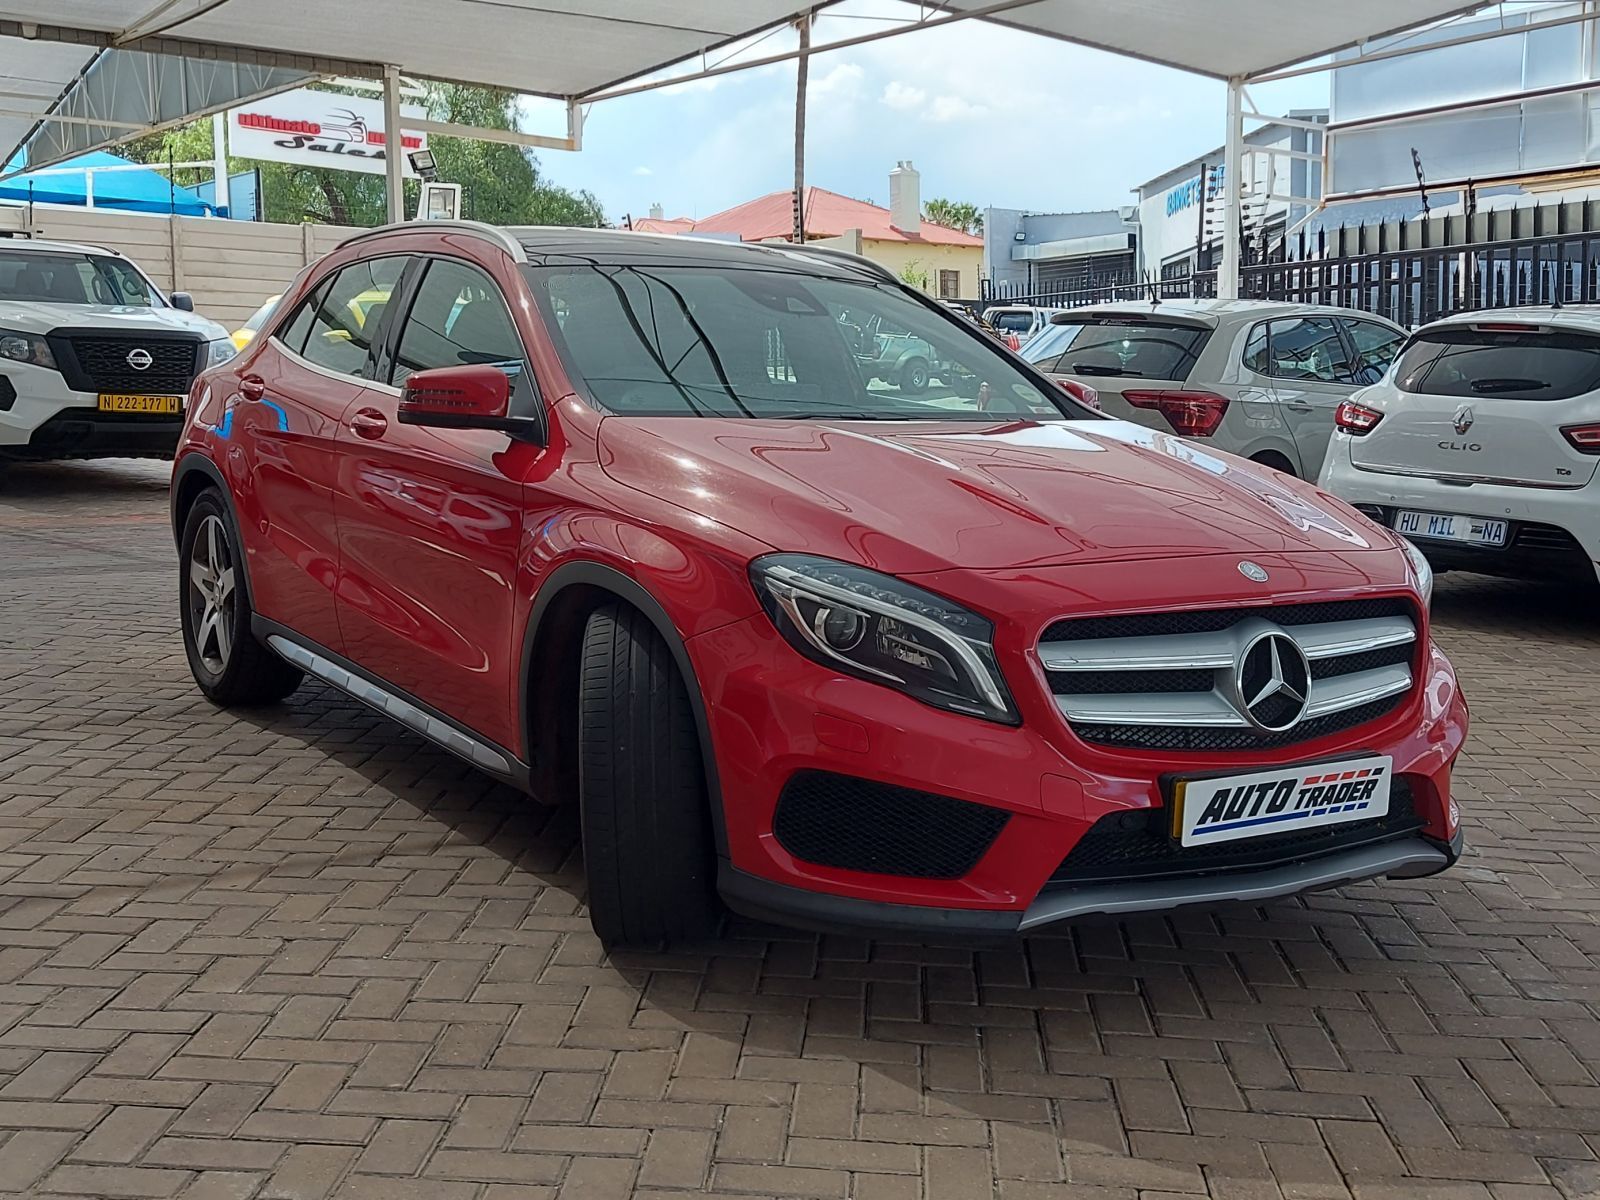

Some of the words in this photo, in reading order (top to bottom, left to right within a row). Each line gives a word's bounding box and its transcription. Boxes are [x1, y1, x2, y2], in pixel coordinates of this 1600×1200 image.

[238, 113, 321, 135] ultimate
[104, 396, 111, 409] N
[117, 397, 161, 411] 222-177
[1437, 441, 1482, 452] CLIO
[1482, 522, 1503, 542] NA
[1196, 778, 1299, 826] AUTO
[1293, 778, 1379, 811] TRADER
